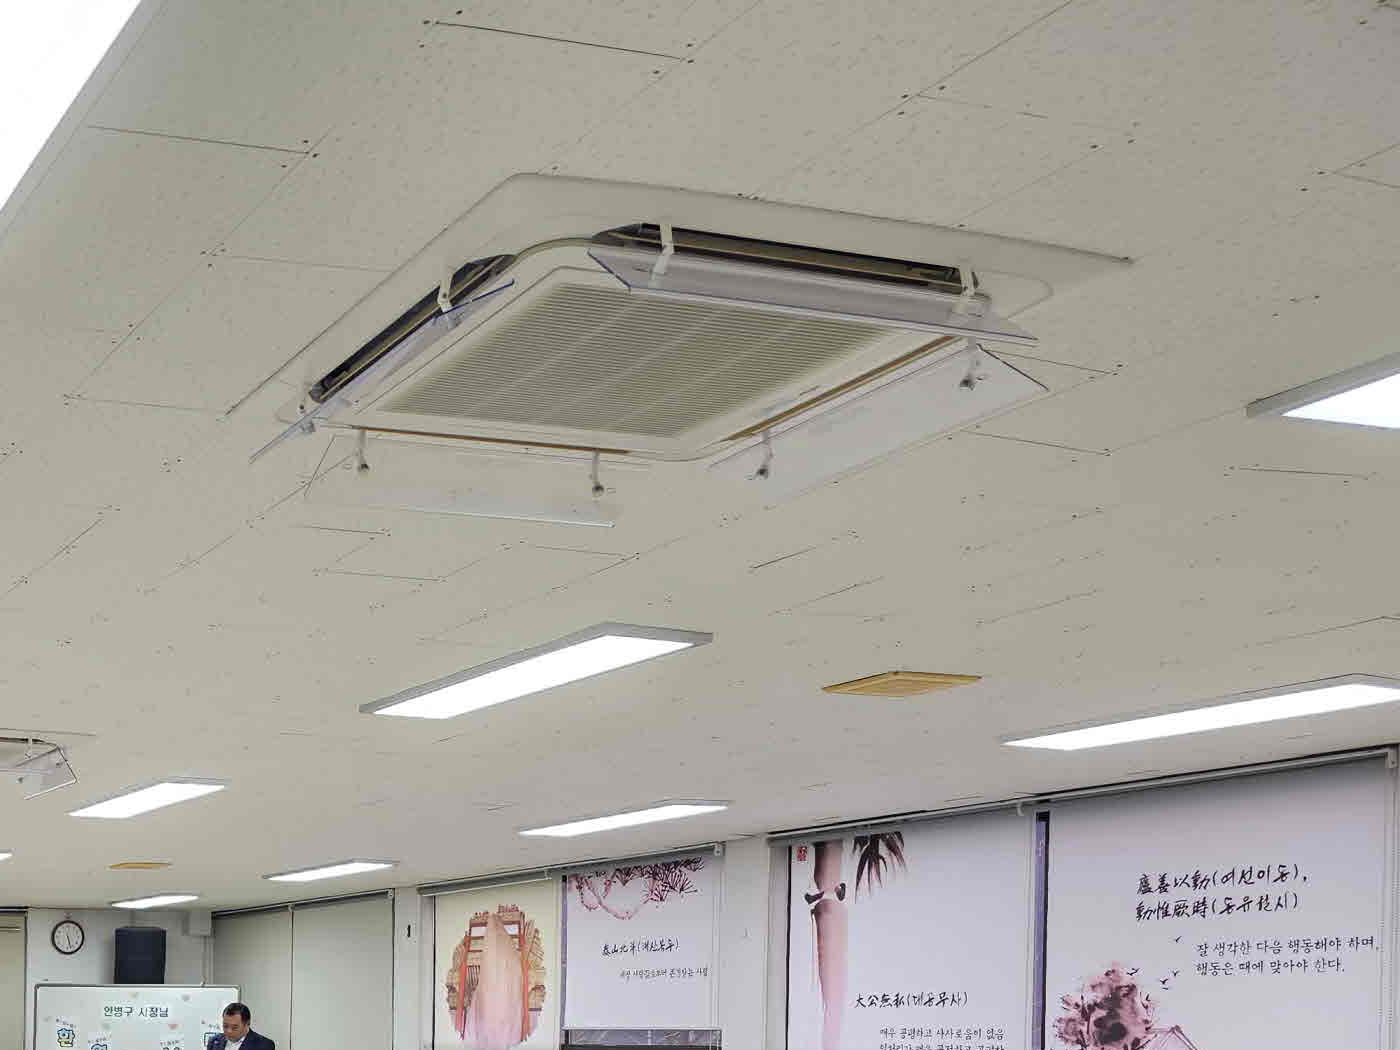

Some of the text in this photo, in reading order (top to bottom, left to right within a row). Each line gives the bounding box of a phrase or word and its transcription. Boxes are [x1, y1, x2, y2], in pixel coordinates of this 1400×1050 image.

[1196, 942, 1209, 957] 잘
[1212, 942, 1252, 956] 생각한
[1256, 940, 1283, 954] 다음
[1288, 938, 1342, 954] 행동해야
[1196, 961, 1234, 977] 행동은
[1238, 960, 1264, 974] 때에
[1269, 958, 1309, 974] 맞아야
[103, 1005, 169, 1018] 안병구 시장님
